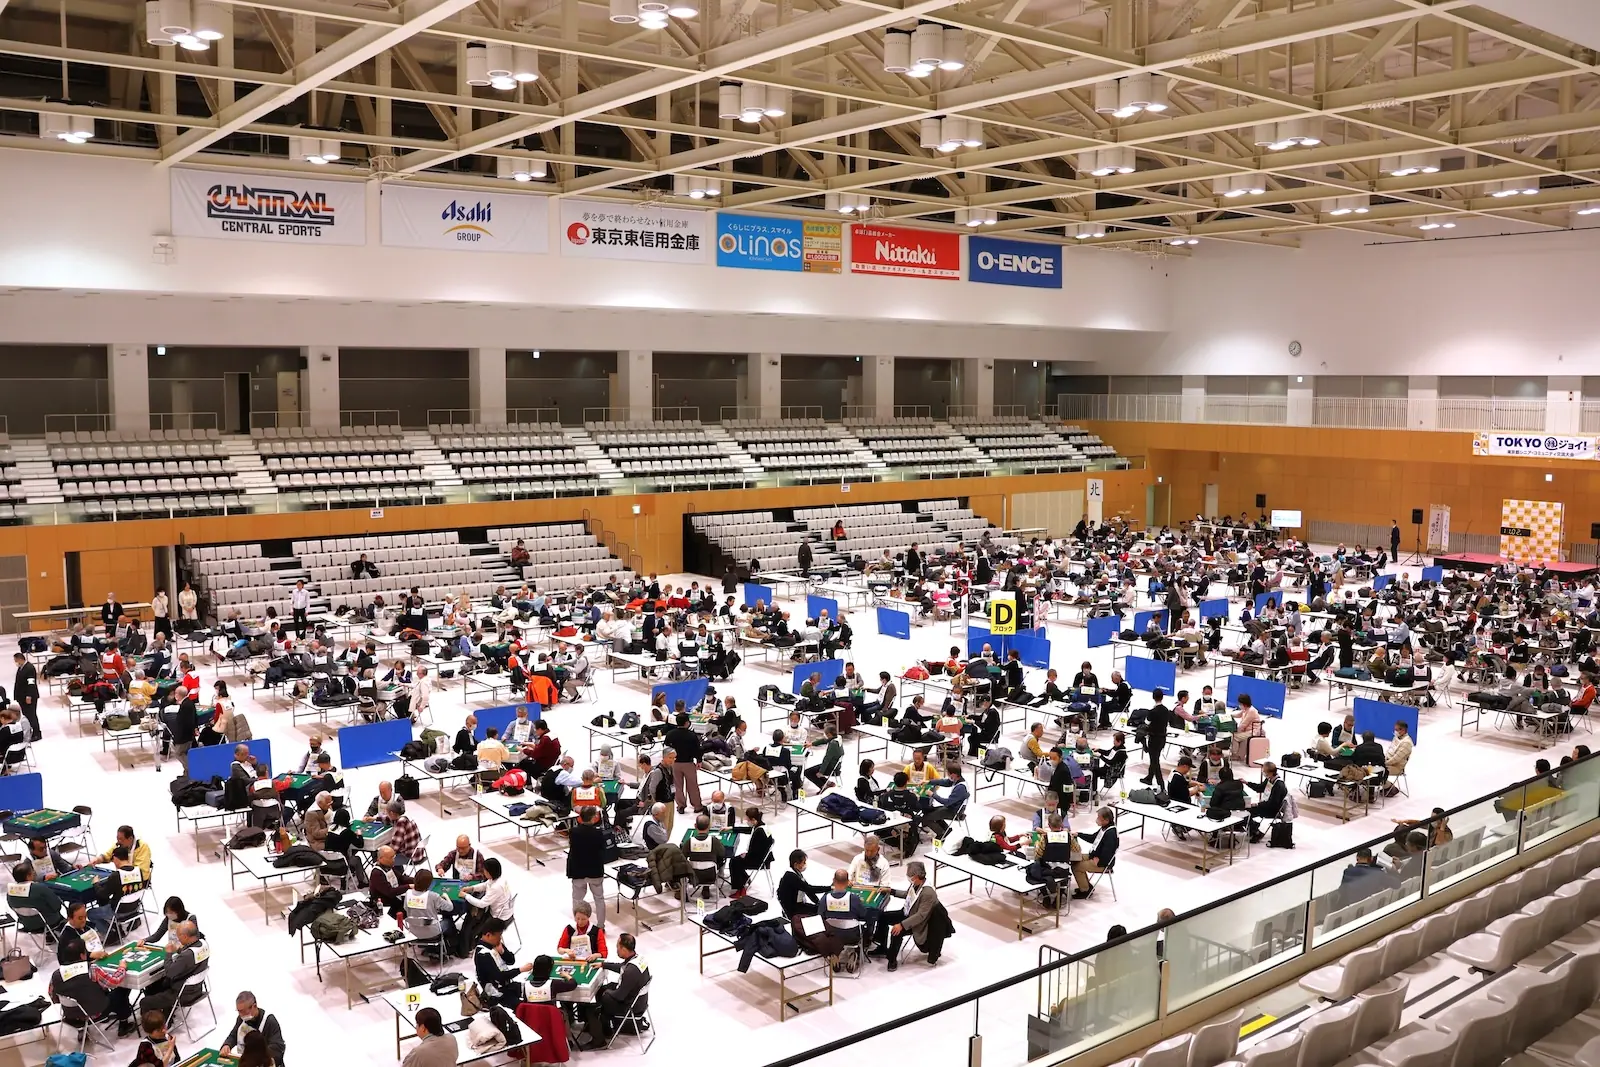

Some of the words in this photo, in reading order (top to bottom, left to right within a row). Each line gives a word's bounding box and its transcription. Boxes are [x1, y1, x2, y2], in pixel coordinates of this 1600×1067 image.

[207, 184, 334, 219] CENTRAL
[441, 199, 491, 222] Asahi
[221, 220, 273, 234] CENTRAL
[278, 224, 321, 237] SPORTS
[582, 212, 689, 229] 夢を夢で終わらせない信用金庫
[456, 232, 481, 241] GROUP
[591, 227, 700, 250] 東京東信用金庫
[875, 239, 937, 265] Nittaku
[1496, 437, 1542, 448] TOKYO
[1090, 481, 1101, 496] 北
[995, 603, 1013, 625] D
[408, 1003, 420, 1011] 17
[409, 994, 417, 1003] D
